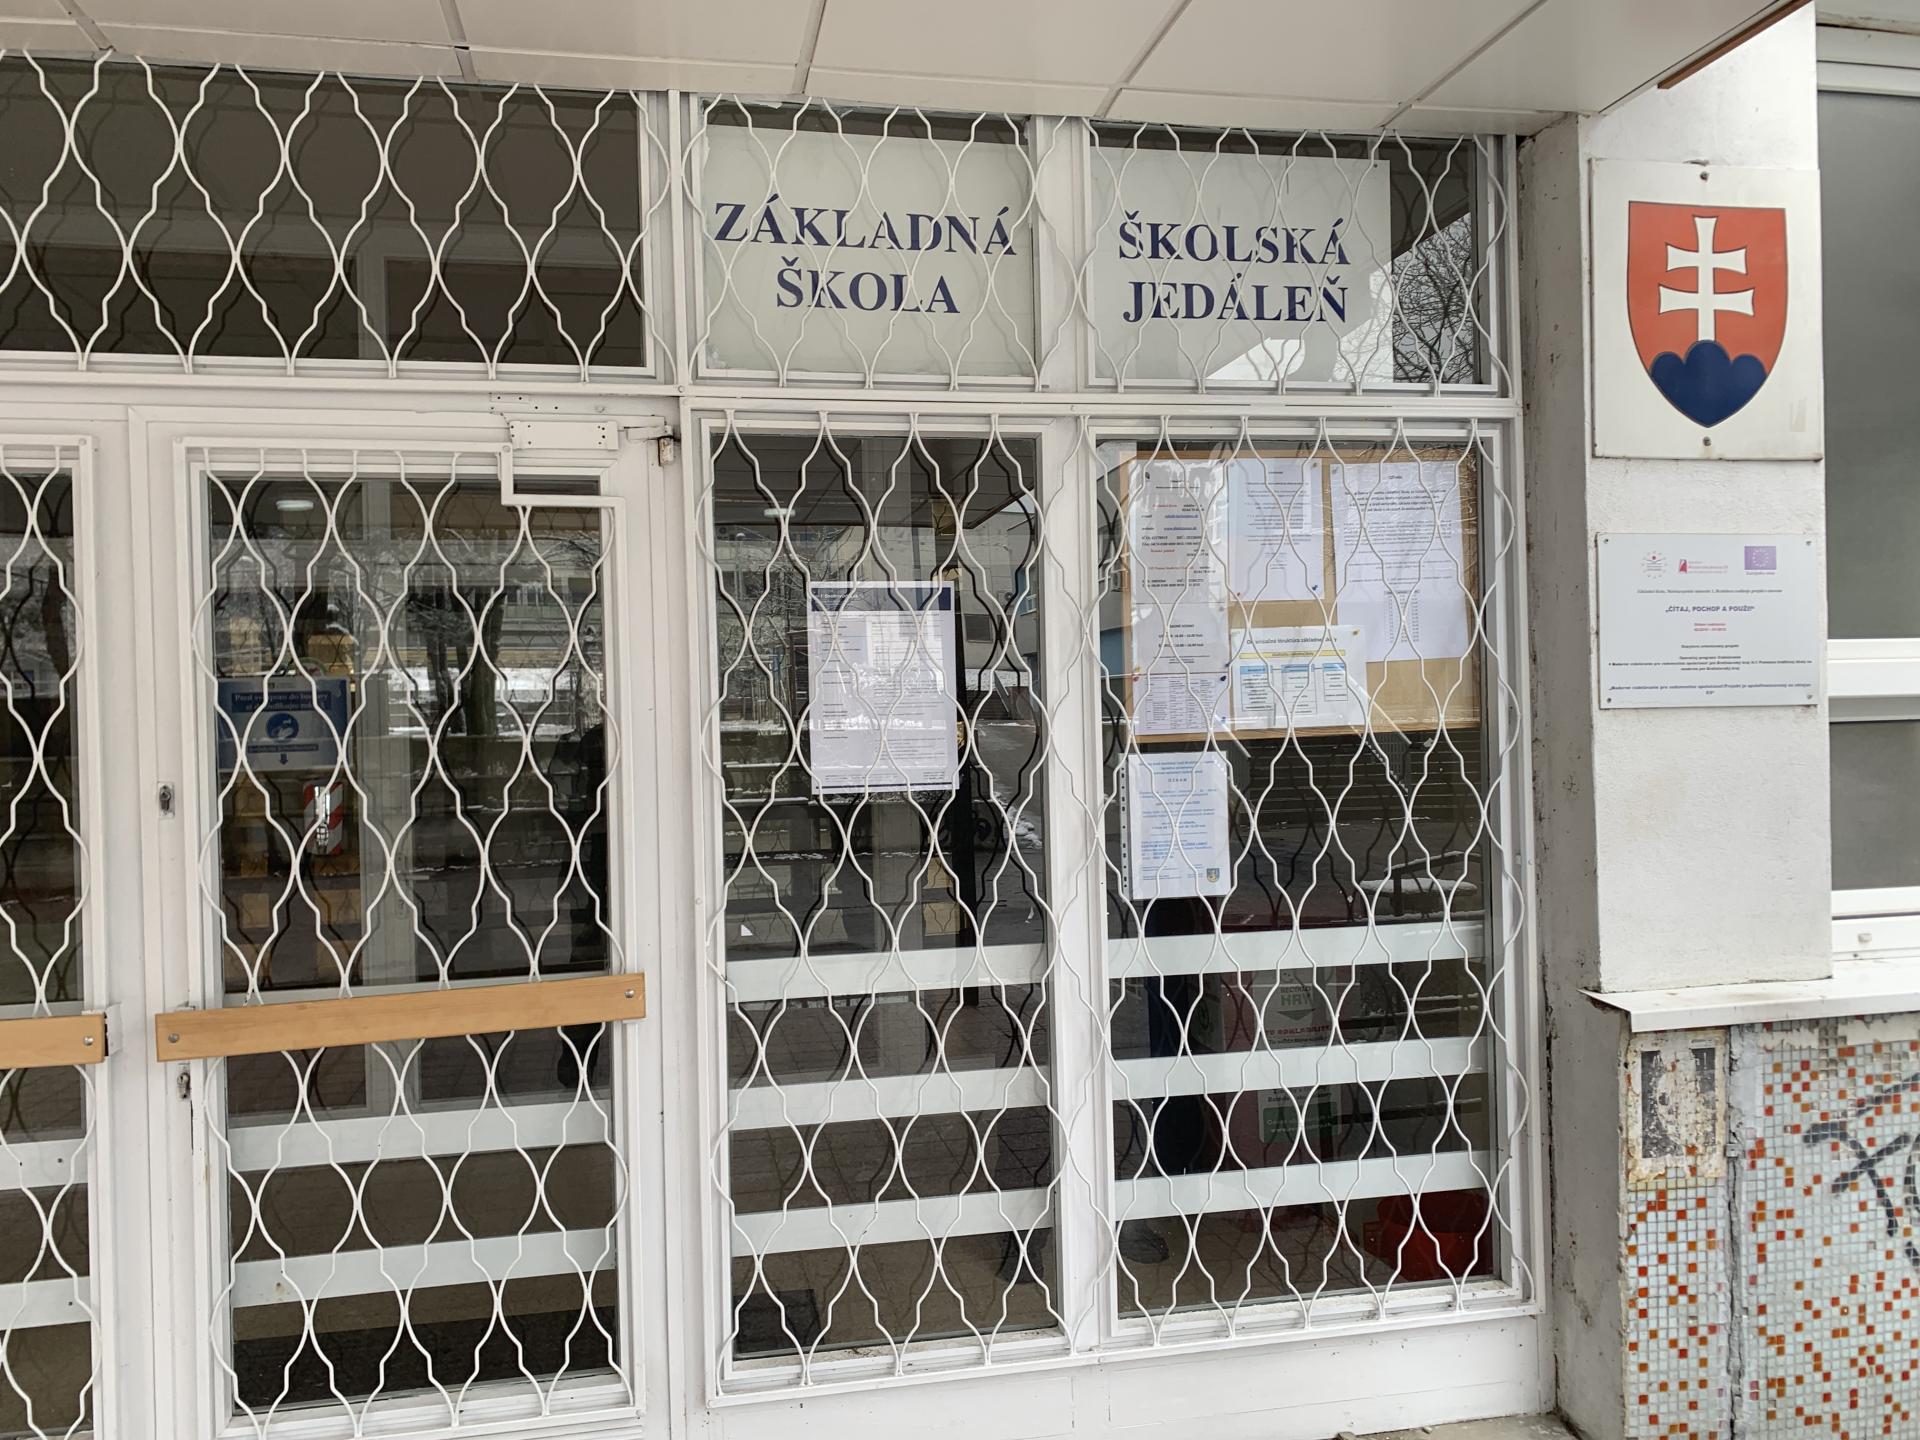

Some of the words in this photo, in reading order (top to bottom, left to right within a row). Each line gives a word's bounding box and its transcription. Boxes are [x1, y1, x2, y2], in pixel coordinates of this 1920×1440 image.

[714, 195, 1017, 256] ZÁKLADNÁ
[1119, 211, 1351, 266] ŠKOLSKÁ
[775, 256, 960, 315] ŠKOLA
[1122, 274, 1349, 323] JEDÁLEŇ
